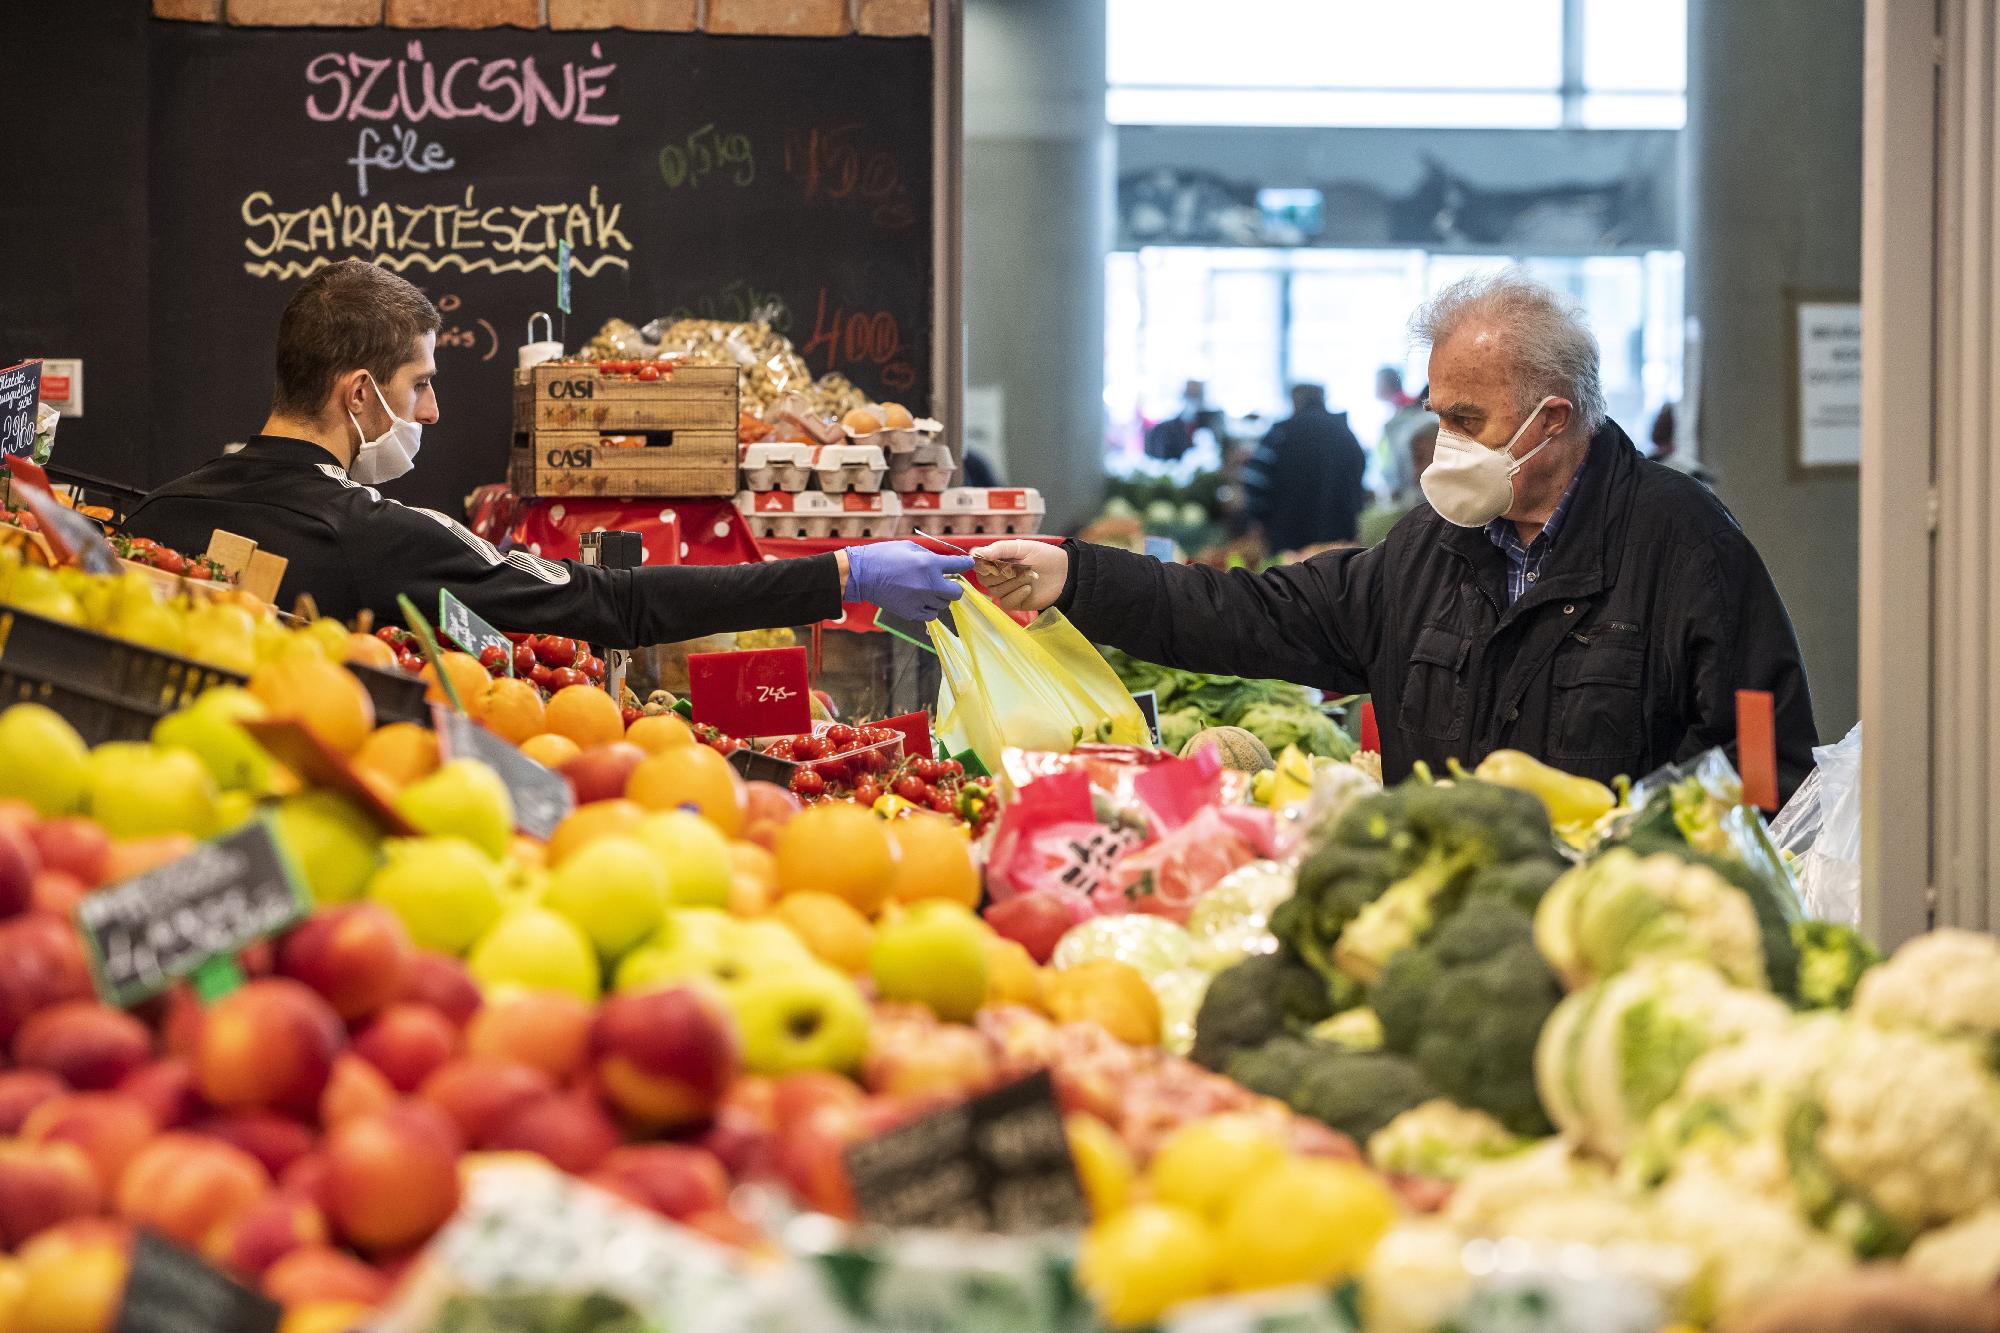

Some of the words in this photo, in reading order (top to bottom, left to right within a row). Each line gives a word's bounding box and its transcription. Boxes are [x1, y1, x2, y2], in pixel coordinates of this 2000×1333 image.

[347, 124, 455, 197] féle
[801, 288, 898, 370] 400
[548, 379, 594, 399] CASI
[546, 448, 593, 468] CASI
